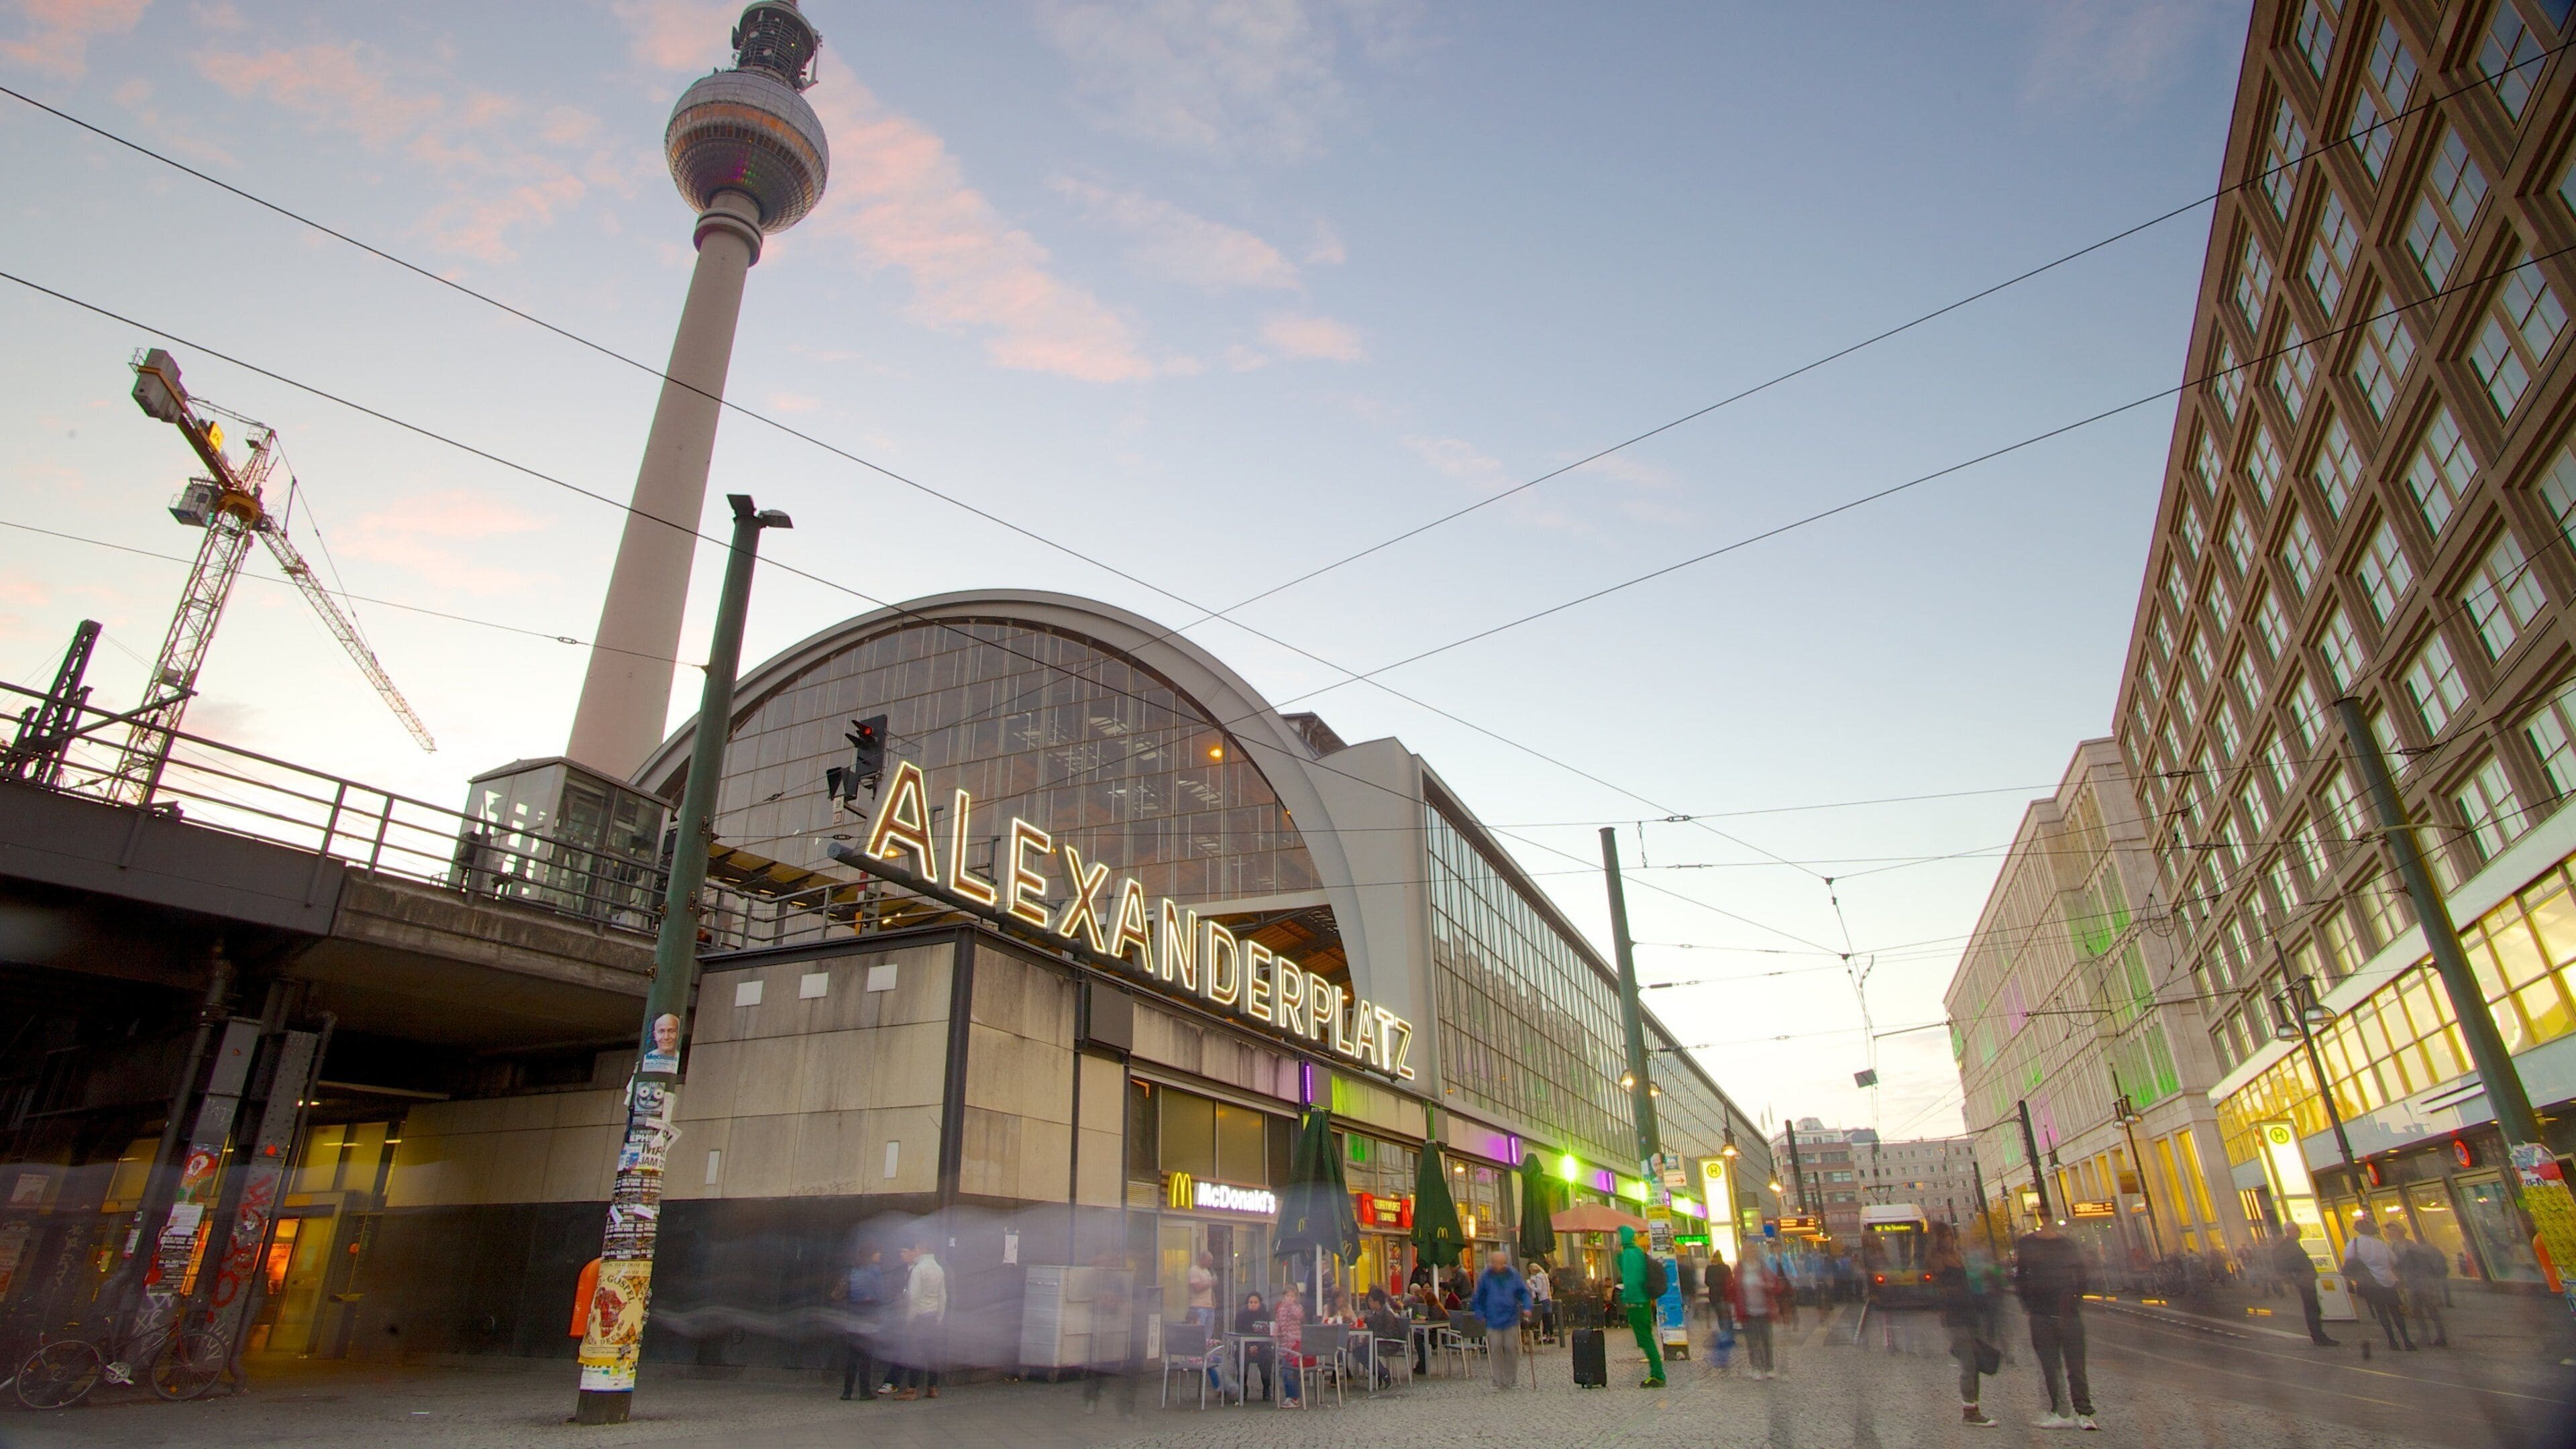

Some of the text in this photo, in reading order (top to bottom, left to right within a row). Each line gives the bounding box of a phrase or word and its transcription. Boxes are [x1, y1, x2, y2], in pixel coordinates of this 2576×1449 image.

[865, 760, 1415, 1081] ALEXANDERPLATZ
[639, 1156, 658, 1167] JAM
[1197, 1182, 1275, 1214] McDonald's
[1374, 1199, 1401, 1212] CURRYWURST
